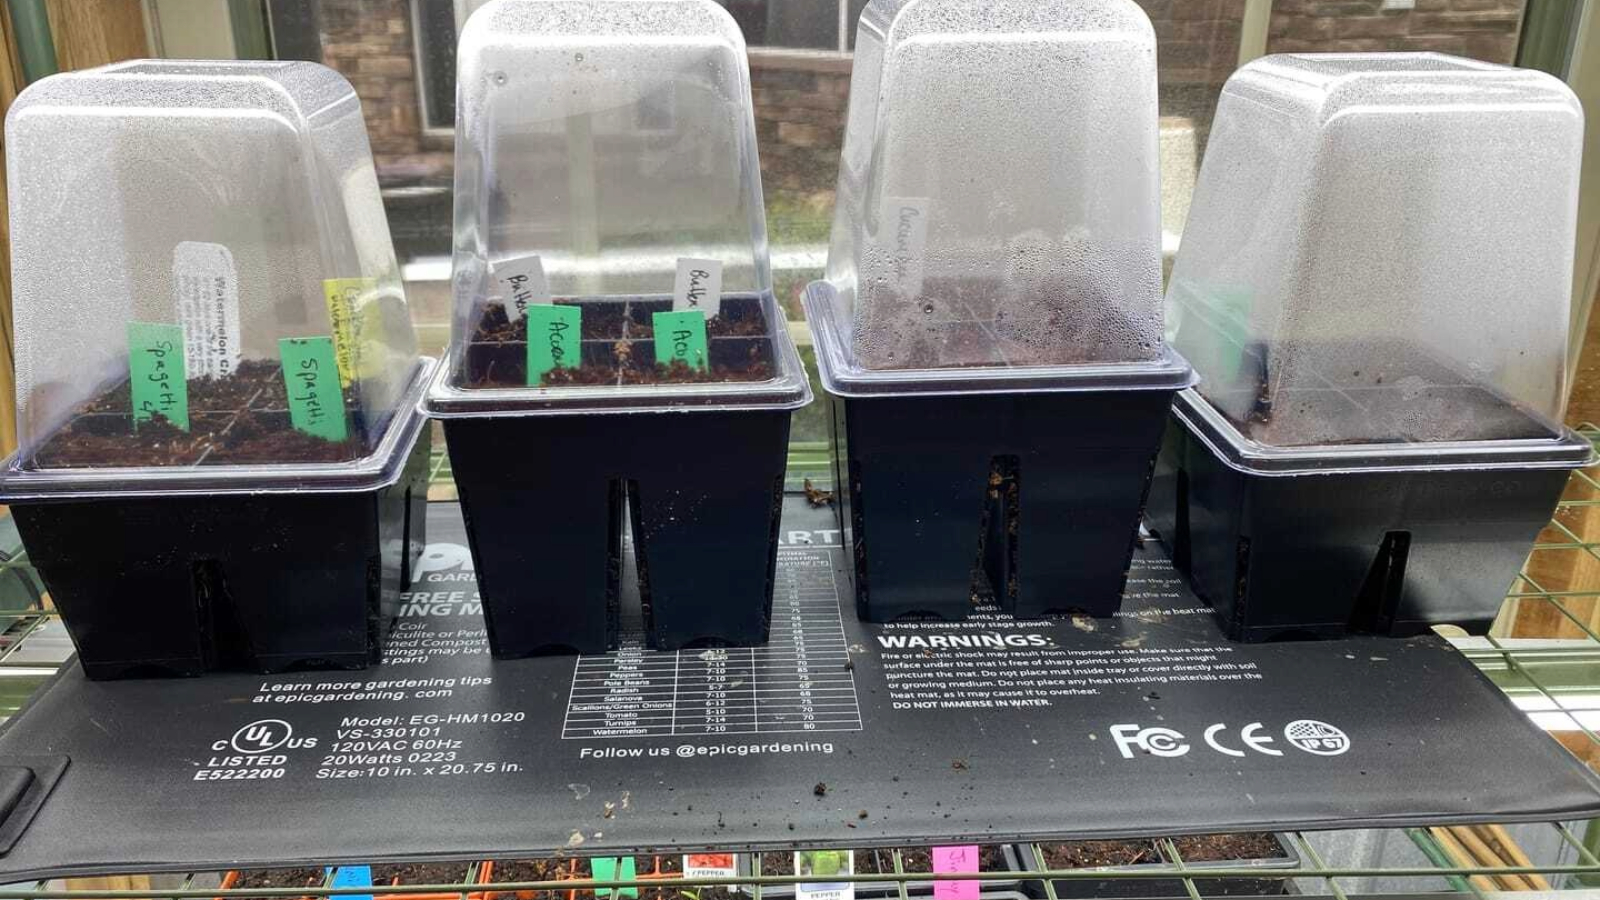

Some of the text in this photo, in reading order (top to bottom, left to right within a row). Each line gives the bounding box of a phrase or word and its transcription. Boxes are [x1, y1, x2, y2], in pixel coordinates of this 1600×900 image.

[400, 604, 450, 616] ING
[896, 622, 918, 630] help
[962, 621, 986, 630] early
[1016, 620, 1055, 629] growth.
[390, 630, 436, 640] iculite
[877, 634, 1056, 648] WARNINGS:
[428, 648, 460, 656] may
[954, 650, 984, 658] shock
[986, 652, 1008, 660] may
[1010, 650, 1038, 658] result
[1068, 648, 1115, 658] improper
[923, 660, 954, 668] under
[1044, 658, 1074, 668] sharp
[1076, 656, 1108, 666] points
[1124, 654, 1159, 665] objects
[1162, 654, 1184, 662] that
[1186, 654, 1217, 664] might
[886, 670, 933, 680] puncture
[1020, 668, 1048, 678] place
[1072, 666, 1104, 676] inside
[1106, 667, 1126, 676] tray
[1172, 664, 1211, 674] directly
[1213, 662, 1236, 670] with
[260, 676, 493, 692] Learn more gardening tips
[901, 680, 946, 690] growing
[948, 680, 996, 688] medium.
[1036, 678, 1064, 688] place
[1067, 678, 1086, 686] any
[1088, 676, 1112, 684] heat
[1114, 674, 1168, 684] insulating
[1170, 673, 1218, 682] materials
[252, 690, 452, 704] at epicgardening. com
[918, 691, 942, 700] mat,
[968, 691, 990, 700] may
[1049, 687, 1101, 696] overheat.
[914, 701, 939, 709] NOT
[941, 700, 994, 708] IMMERSE
[996, 700, 1008, 708] IN
[1009, 698, 1053, 708] WATER.
[340, 712, 526, 728] Model: EG-HM1020
[336, 727, 441, 740] VS-330101
[592, 728, 648, 736] Watermelon
[286, 738, 319, 749] US
[330, 739, 463, 752] 120VAC 60Hz
[1203, 722, 1285, 758] CE
[580, 742, 834, 759] Follow us @epicgardening
[208, 755, 288, 766] LISTED
[320, 752, 456, 766] 20Watts 0223
[193, 768, 286, 781] E522200
[394, 766, 416, 776] in.
[439, 762, 496, 775] 20.75
[500, 762, 524, 772] in.
